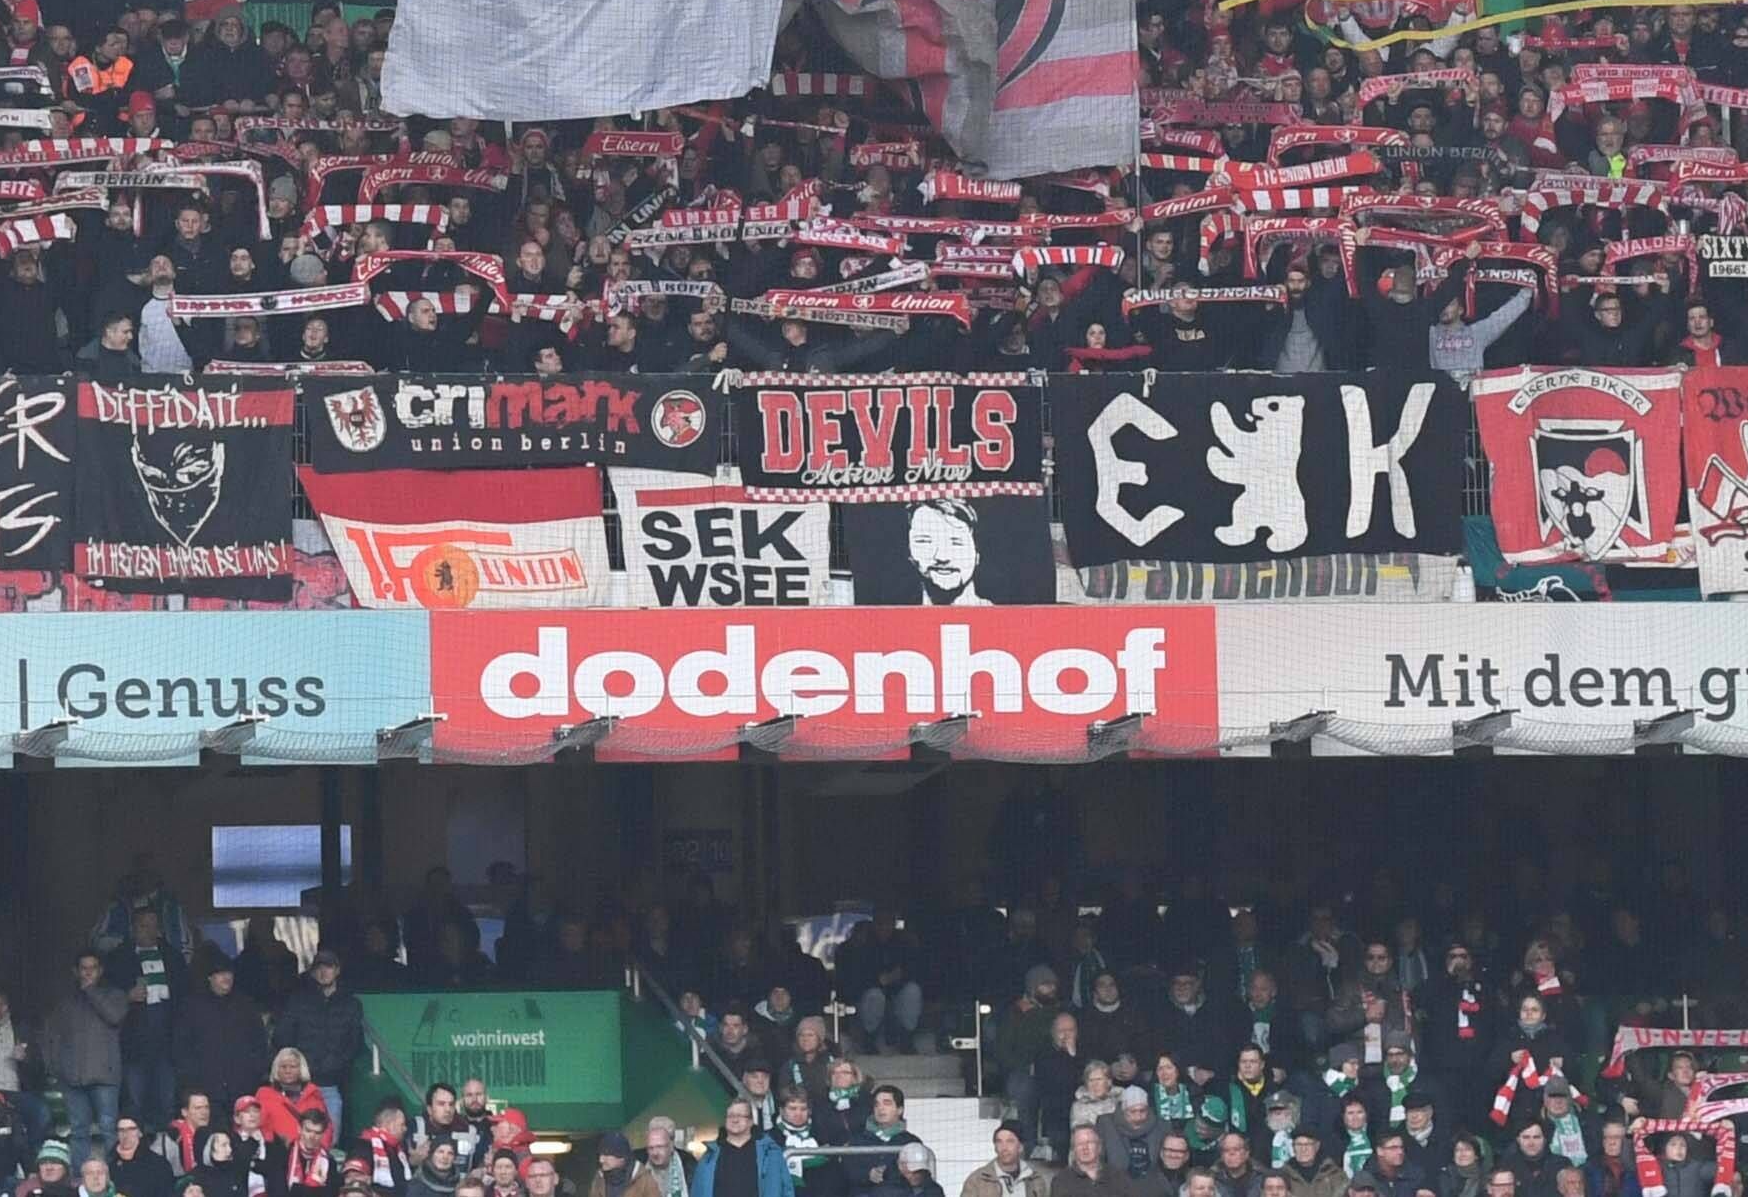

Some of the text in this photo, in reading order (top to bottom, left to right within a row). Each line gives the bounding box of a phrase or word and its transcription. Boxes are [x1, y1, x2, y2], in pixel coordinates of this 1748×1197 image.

[601, 135, 660, 153] Eisern
[1677, 159, 1738, 181] Eisern
[1154, 193, 1218, 215] Union
[770, 293, 956, 310] Eisern Union
[1588, 374, 1649, 412] BIKER
[410, 432, 627, 455] union berlin
[758, 386, 1019, 475] DEVILS
[641, 508, 808, 561] SEK
[649, 564, 811, 607] WSEE
[479, 622, 1167, 717] dodenhof
[1383, 652, 1500, 708] Mit
[1523, 653, 1676, 708] dem
[56, 662, 328, 720] Genuss
[451, 1027, 546, 1049] wohninvest
